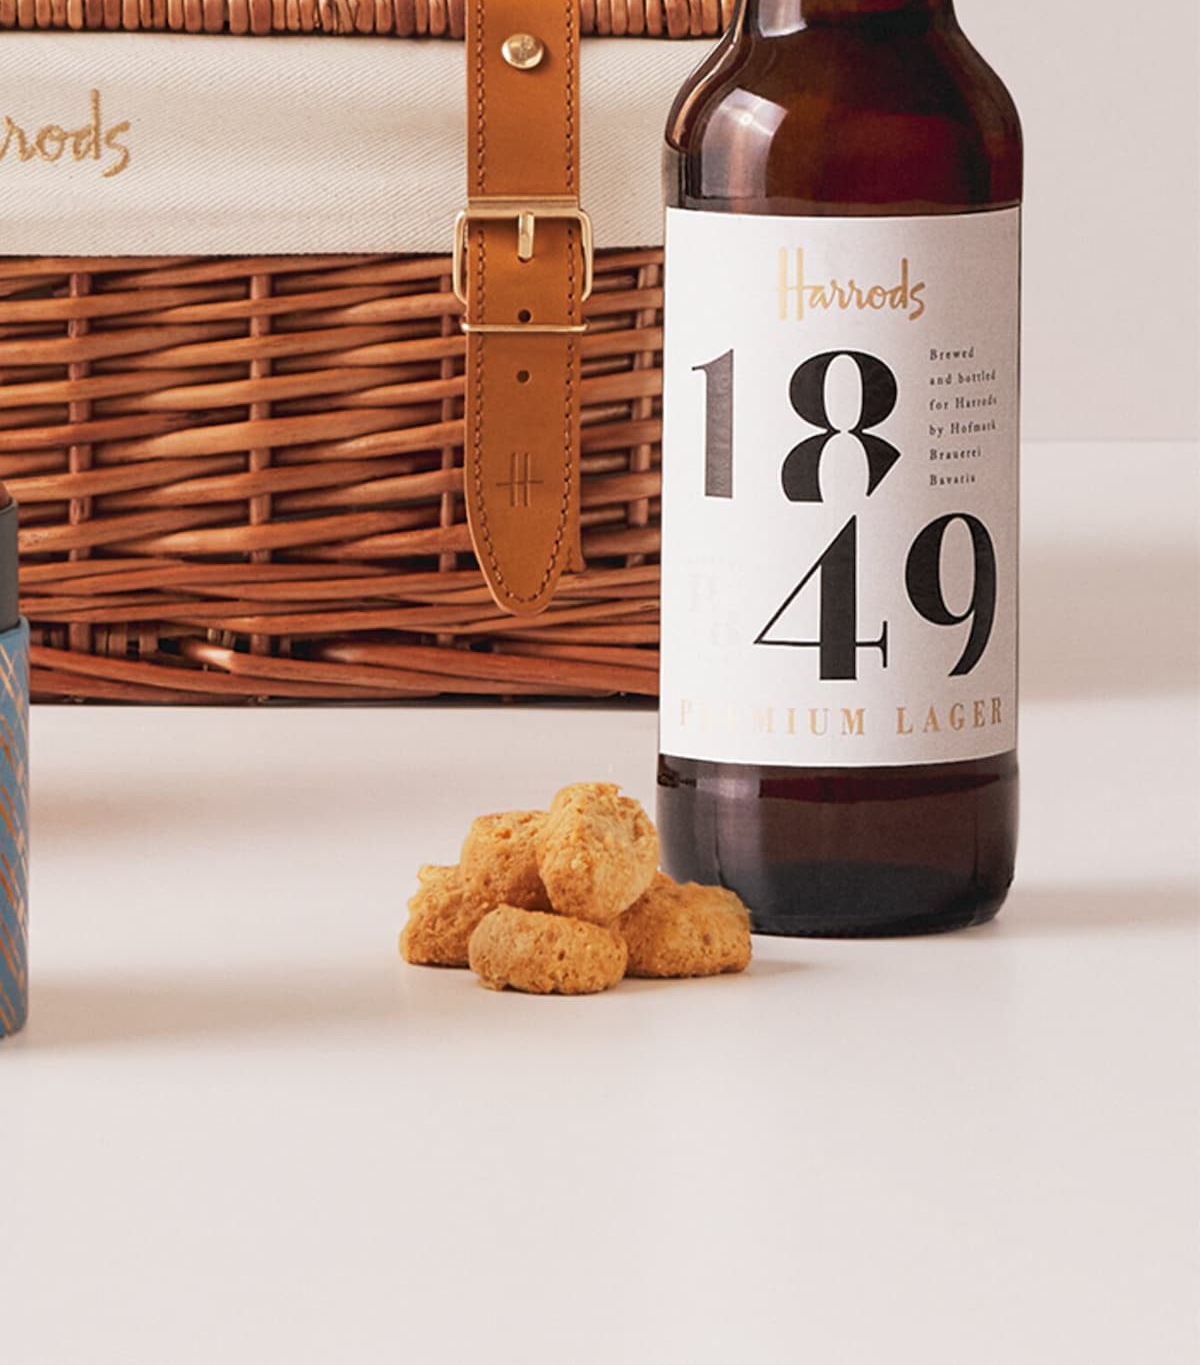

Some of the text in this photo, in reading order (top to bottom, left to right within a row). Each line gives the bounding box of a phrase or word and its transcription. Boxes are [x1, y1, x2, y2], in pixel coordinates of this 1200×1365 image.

[776, 246, 926, 321] Harrods
[929, 346, 975, 361] Brewed
[930, 368, 996, 386] and bottled
[929, 394, 997, 411] for Harrods
[929, 424, 944, 438] by
[680, 696, 1002, 736] PMIUM LAGER
